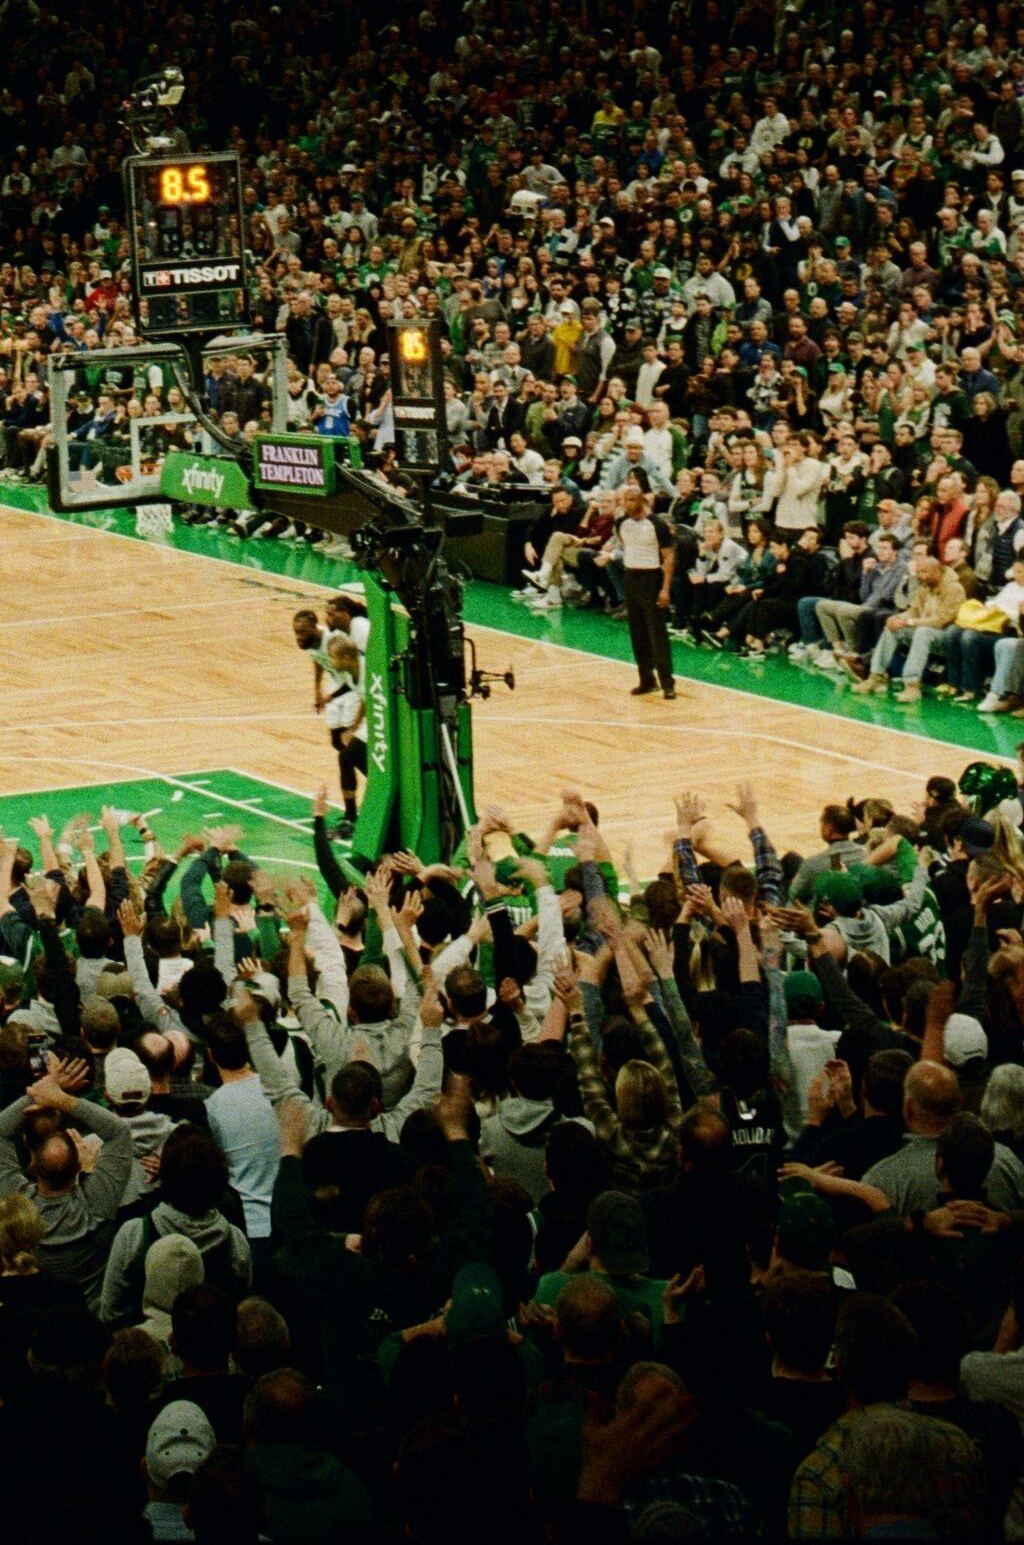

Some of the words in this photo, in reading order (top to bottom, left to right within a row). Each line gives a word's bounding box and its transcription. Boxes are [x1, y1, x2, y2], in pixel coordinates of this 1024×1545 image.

[161, 166, 211, 202] 8.5
[173, 264, 240, 285] TISSOT
[261, 444, 319, 467] FRANKLIN
[182, 462, 225, 499] xfinity
[259, 462, 324, 486] TEMPLETON
[370, 674, 388, 774] xfinity
